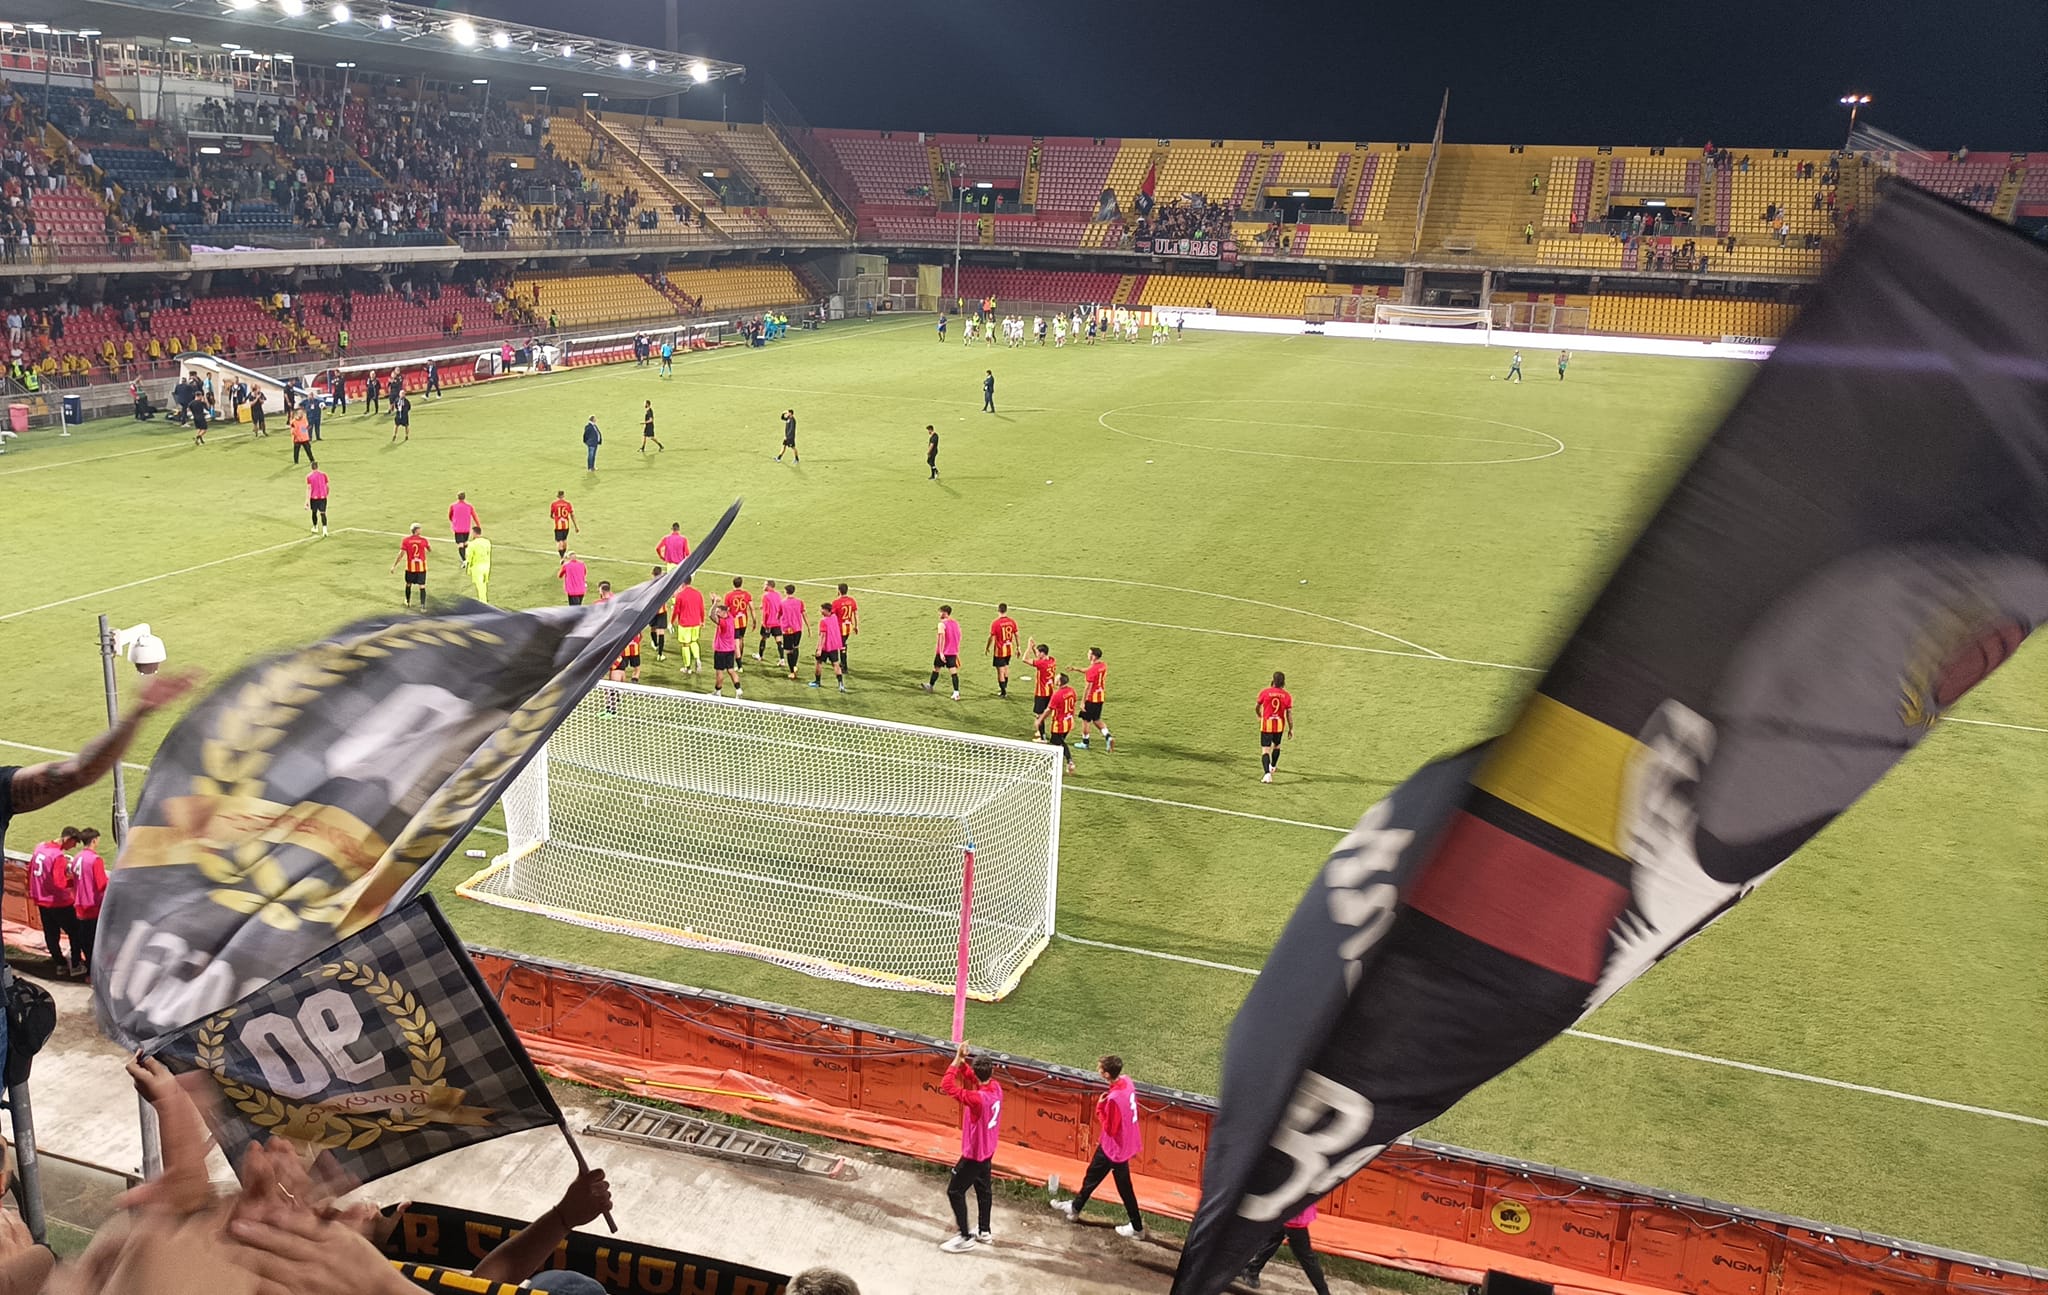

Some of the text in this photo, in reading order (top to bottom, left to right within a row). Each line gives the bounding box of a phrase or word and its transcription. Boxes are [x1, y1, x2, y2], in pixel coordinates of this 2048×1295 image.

[1733, 336, 1761, 345] TEAM
[557, 507, 568, 518] 16
[412, 543, 420, 557] 2
[733, 598, 746, 611] 96
[841, 606, 852, 619] 21
[1001, 625, 1013, 641] 18
[1064, 697, 1074, 713] 10
[1271, 697, 1280, 714] 9
[33, 852, 46, 877] 5
[73, 856, 83, 880] 4
[519, 995, 541, 1008] NGM
[617, 1015, 640, 1028] NGM
[718, 1037, 742, 1050] NGM
[822, 1058, 849, 1073] NGM
[987, 1100, 1001, 1129] 2
[1047, 1108, 1076, 1125] NGM
[1168, 1137, 1200, 1153] NGM
[1430, 1194, 1466, 1210] NGM
[1573, 1224, 1610, 1241] NGM
[1725, 1256, 1762, 1275] NGM
